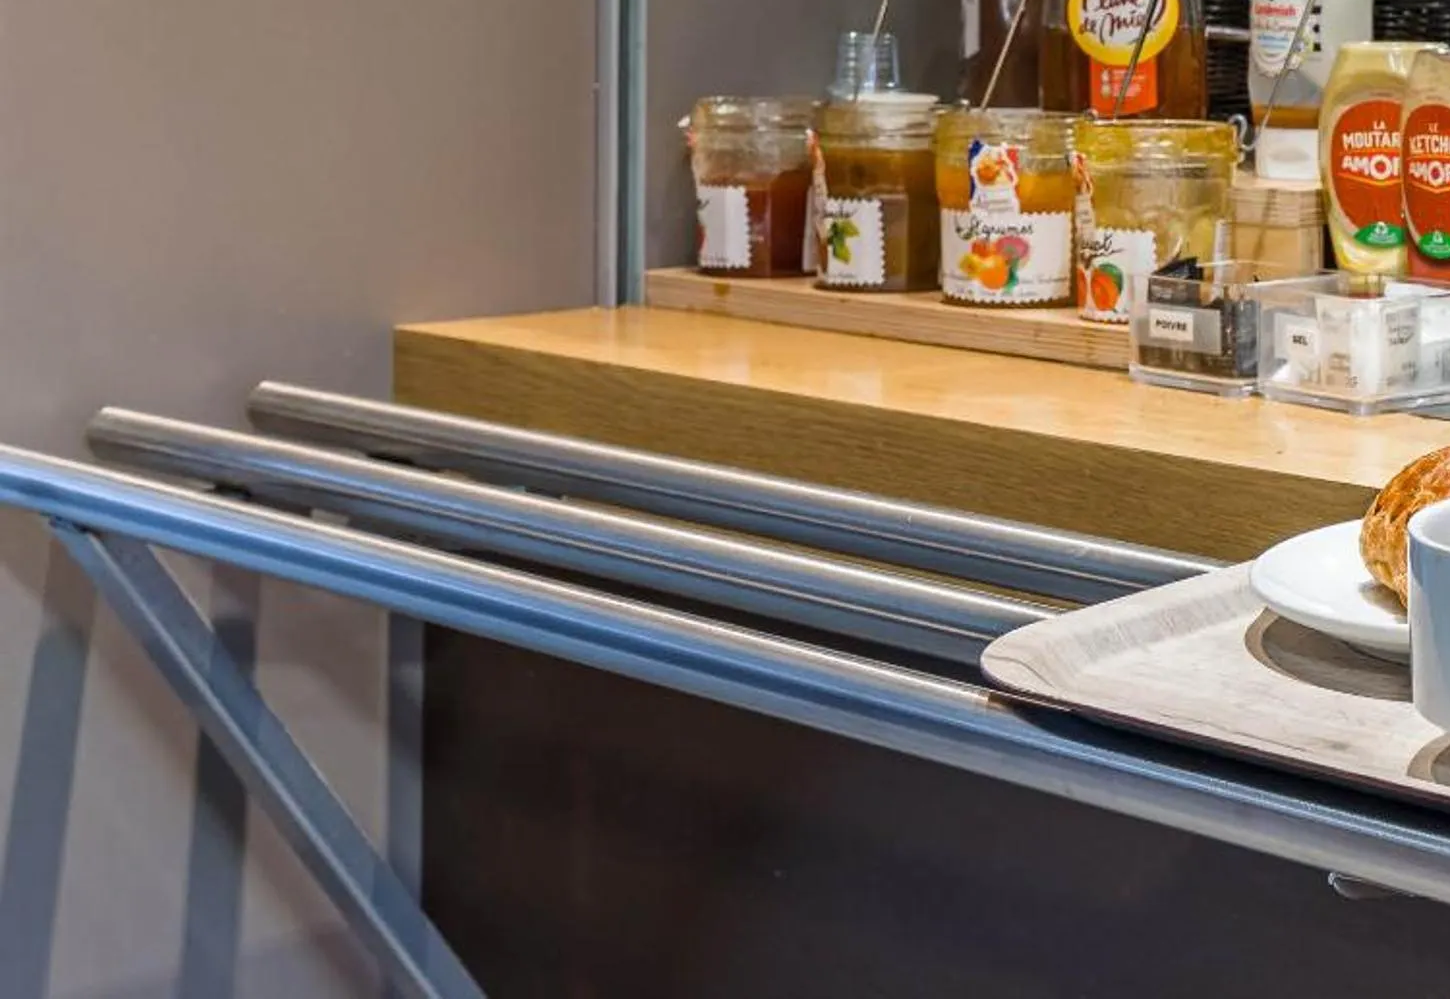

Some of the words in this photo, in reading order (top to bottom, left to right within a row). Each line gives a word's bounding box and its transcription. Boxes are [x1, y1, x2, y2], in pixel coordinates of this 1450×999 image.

[1372, 120, 1386, 130] LA
[1342, 130, 1401, 150] MOUTAR
[1155, 317, 1188, 332] POIVRE
